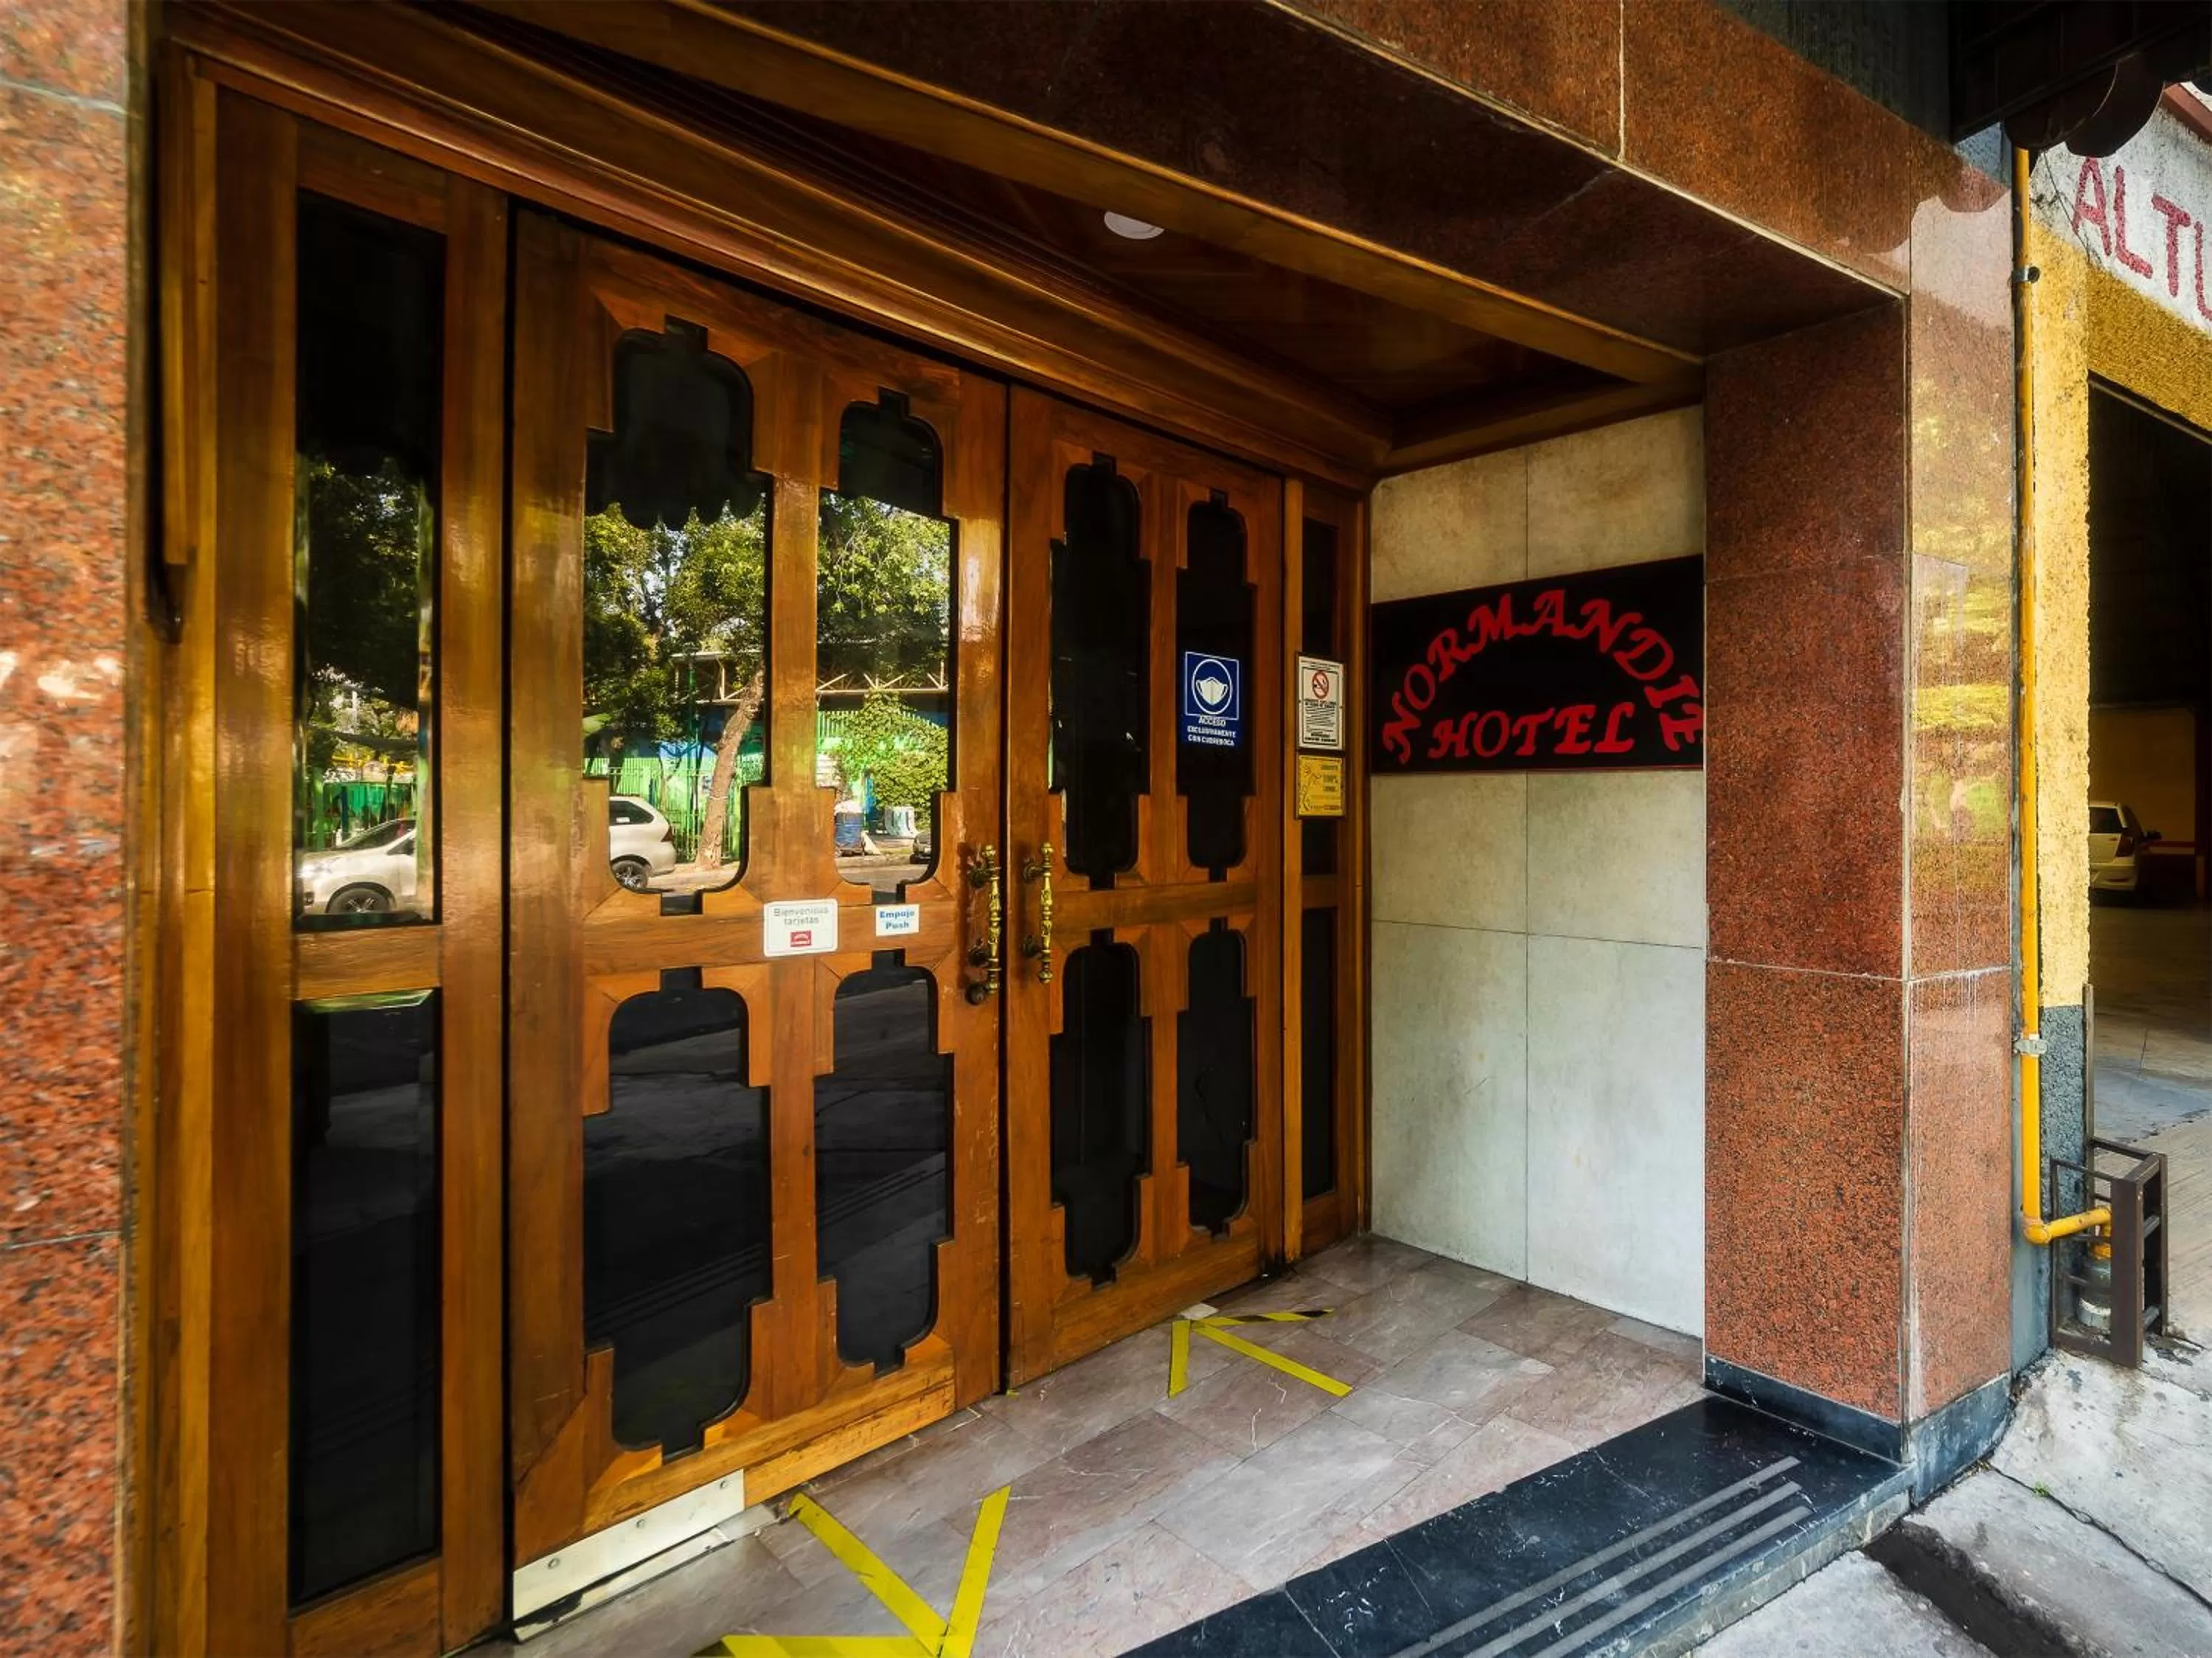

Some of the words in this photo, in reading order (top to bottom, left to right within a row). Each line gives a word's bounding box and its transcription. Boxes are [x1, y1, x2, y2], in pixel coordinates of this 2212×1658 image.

[1382, 589, 1703, 764] NORMANDIE
[1198, 715, 1226, 726] ACCESO
[1187, 725, 1237, 738] EXCLUSIVAMENTE
[1427, 701, 1635, 759] HOTEL
[1188, 735, 1201, 743] CON
[880, 909, 915, 919] Empuje
[784, 917, 819, 926] tarjetas
[886, 921, 909, 929] Push
